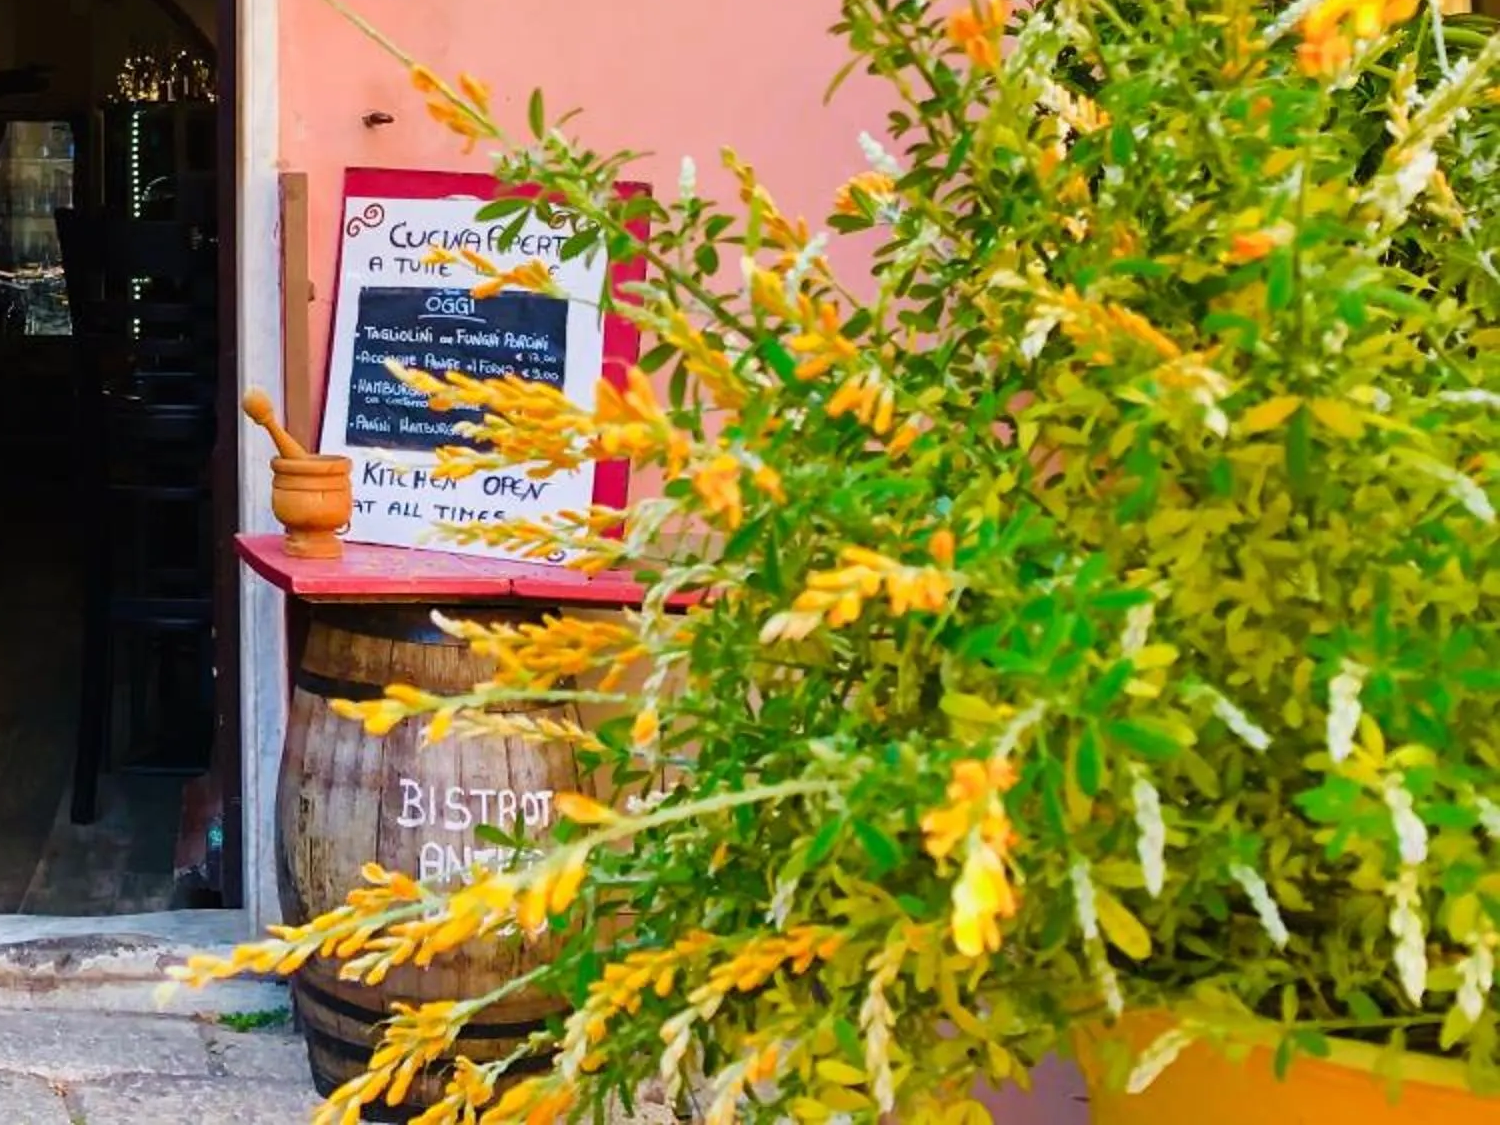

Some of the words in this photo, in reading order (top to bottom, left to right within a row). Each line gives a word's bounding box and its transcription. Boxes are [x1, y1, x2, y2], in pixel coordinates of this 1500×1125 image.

[389, 221, 481, 252] CUCINA
[487, 225, 569, 259] APERT
[369, 256, 383, 272] A
[426, 296, 475, 315] OGGI
[364, 326, 434, 344] TAGLIOLINI
[503, 332, 550, 351] PORCINI
[400, 417, 456, 437] HAMBURG
[362, 461, 458, 493] KITCHEN
[483, 475, 554, 502] OPEN
[353, 499, 376, 514] AT
[387, 501, 422, 518] ALL
[397, 778, 554, 831] BISTROT
